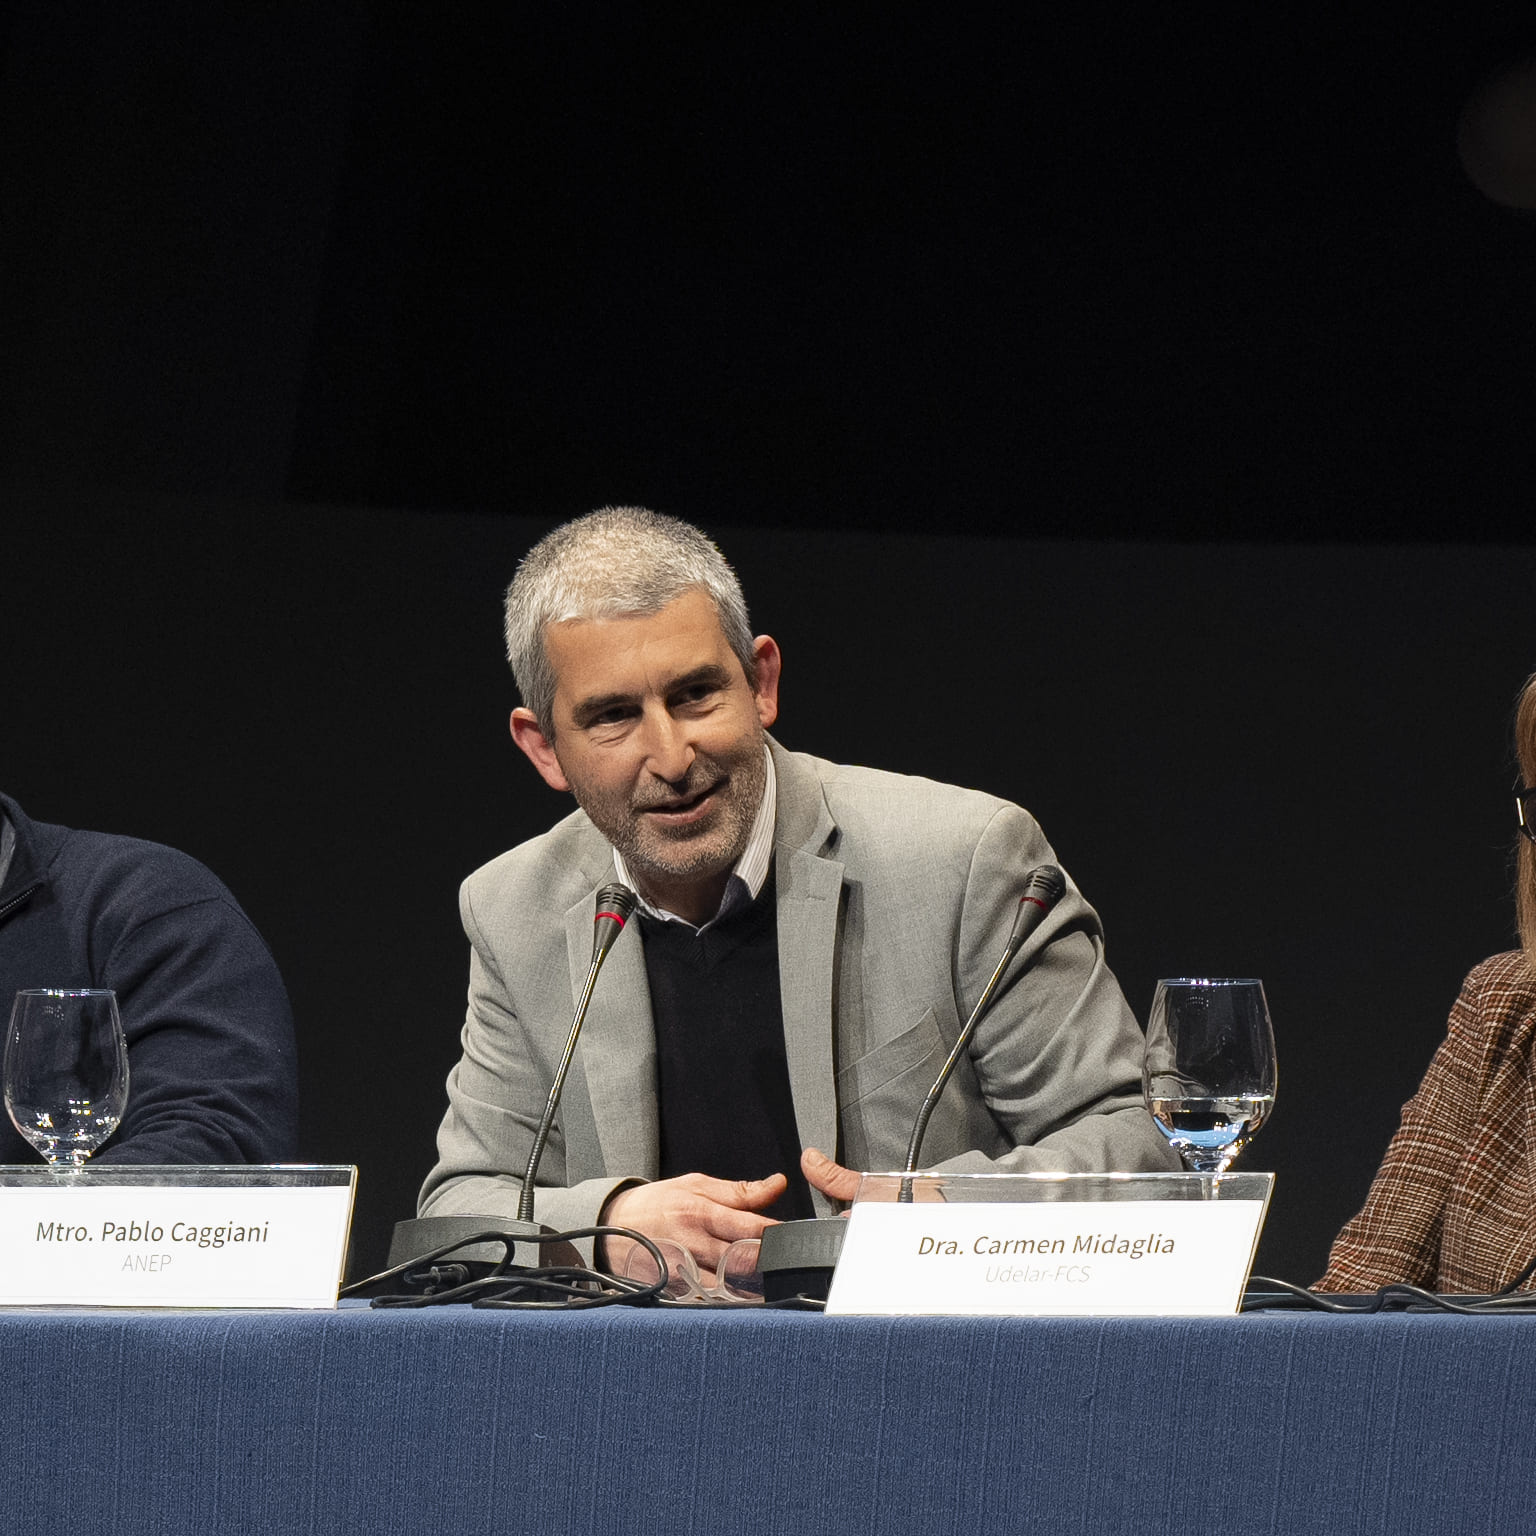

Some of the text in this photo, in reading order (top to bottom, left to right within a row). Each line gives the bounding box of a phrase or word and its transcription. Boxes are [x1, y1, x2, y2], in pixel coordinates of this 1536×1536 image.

[36, 1220, 270, 1249] Mtro. Pablo Caggiani
[917, 1233, 1175, 1260] Dra. Carmen Midaglia
[121, 1254, 174, 1273] ANEP
[985, 1264, 1091, 1284] Udelar-FCS
